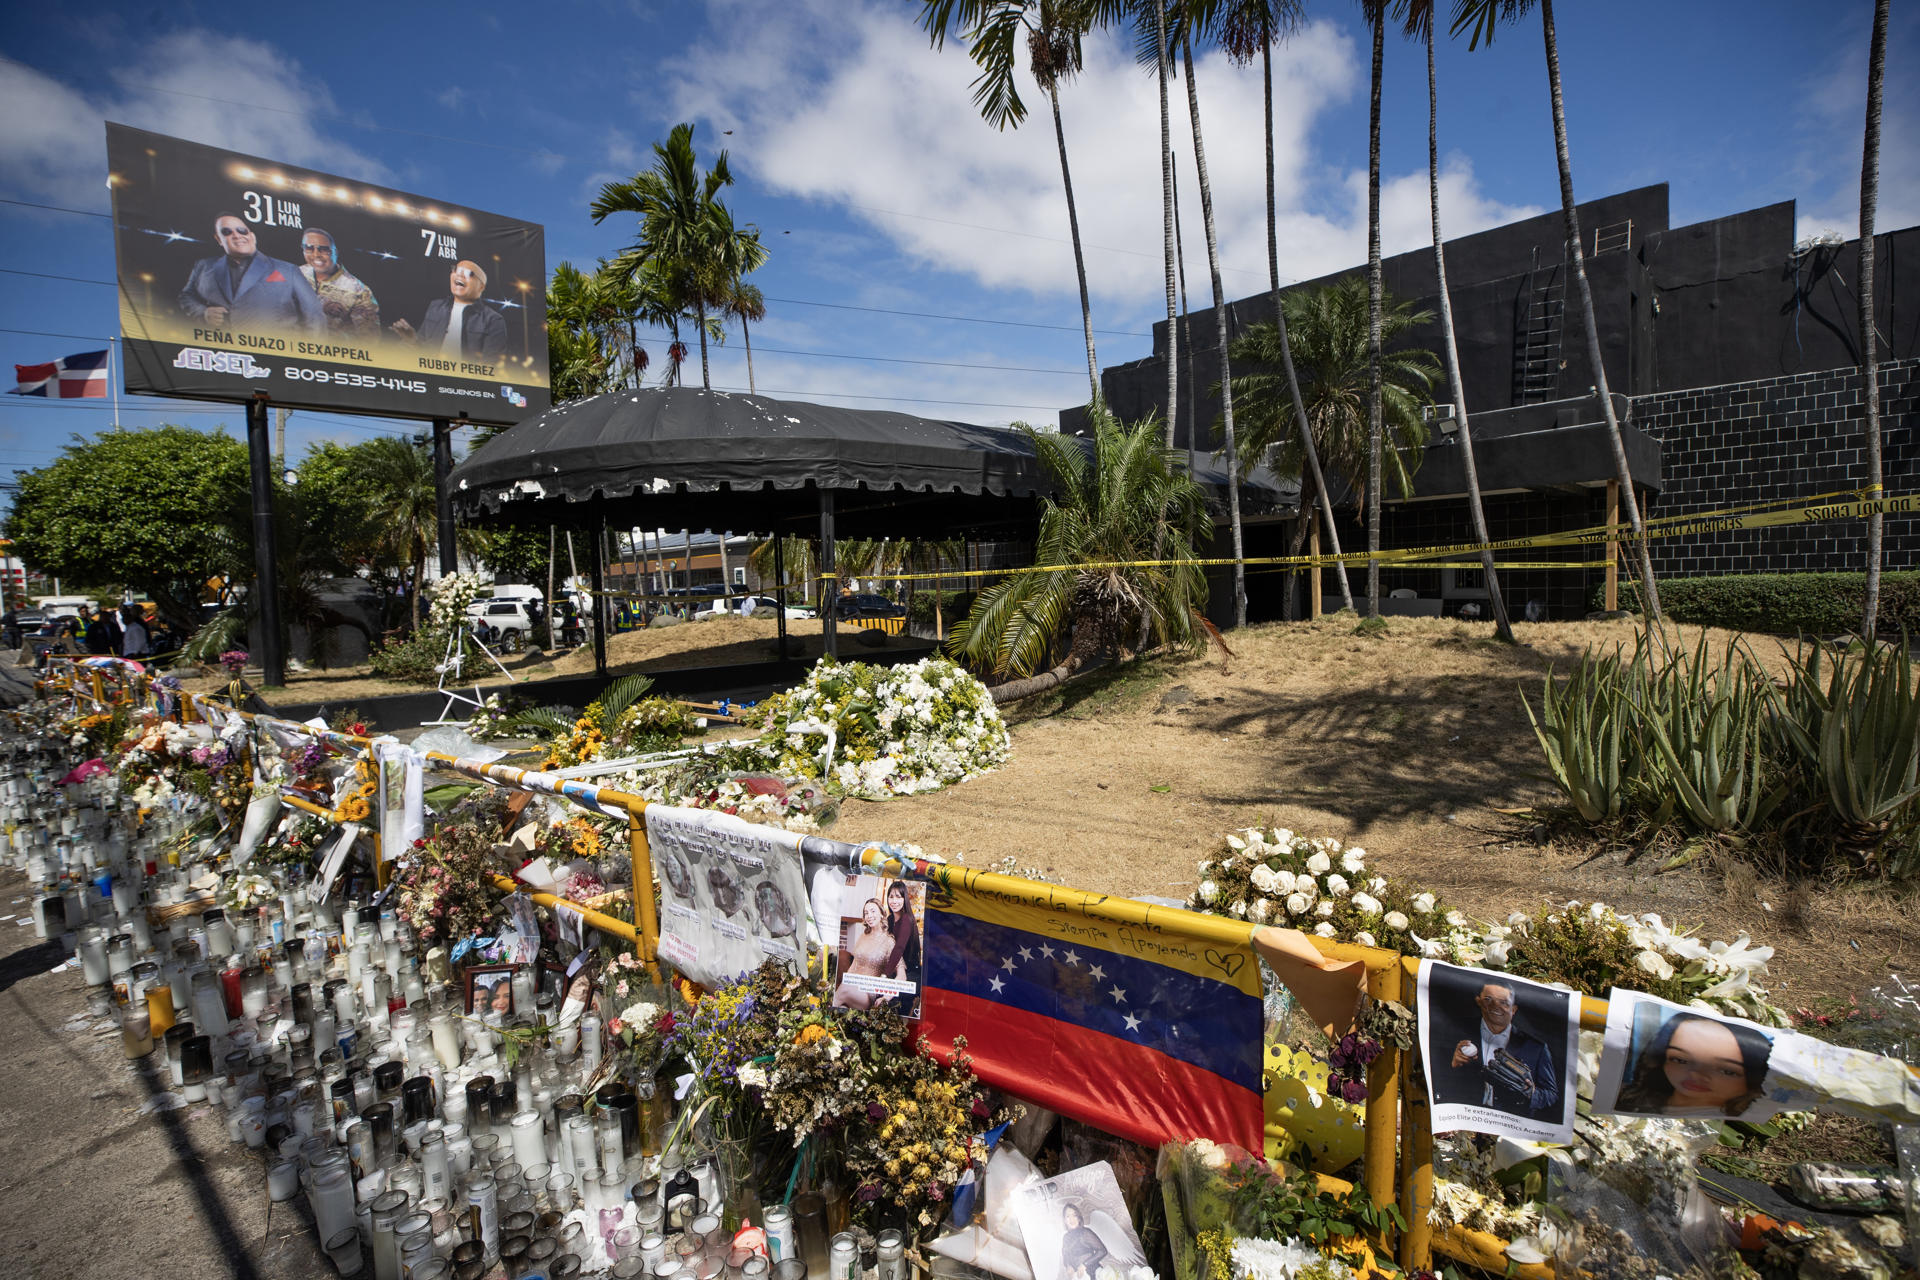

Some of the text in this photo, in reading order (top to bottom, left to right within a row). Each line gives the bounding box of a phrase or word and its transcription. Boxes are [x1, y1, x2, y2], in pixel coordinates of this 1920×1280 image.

[243, 191, 300, 226] 31 LUN
[278, 212, 303, 229] MAR
[421, 229, 457, 257] 7 LUN
[438, 246, 458, 260] ABR
[193, 328, 373, 362] PEÑA SUAZO SEXAPPEAL
[173, 348, 256, 375] JETSET
[419, 357, 495, 377] RUBBY PEREZ
[284, 367, 427, 394] 809-535-4145
[438, 386, 496, 399] SIGUENOS EN:
[1804, 505, 1850, 521] CROSS
[1857, 501, 1883, 516] NOT
[1890, 498, 1911, 513] DO
[1658, 526, 1684, 538] LINE
[1686, 517, 1743, 534] SECURITY
[1484, 1117, 1522, 1131] Gymnastics
[1523, 1127, 1555, 1138] Academy
